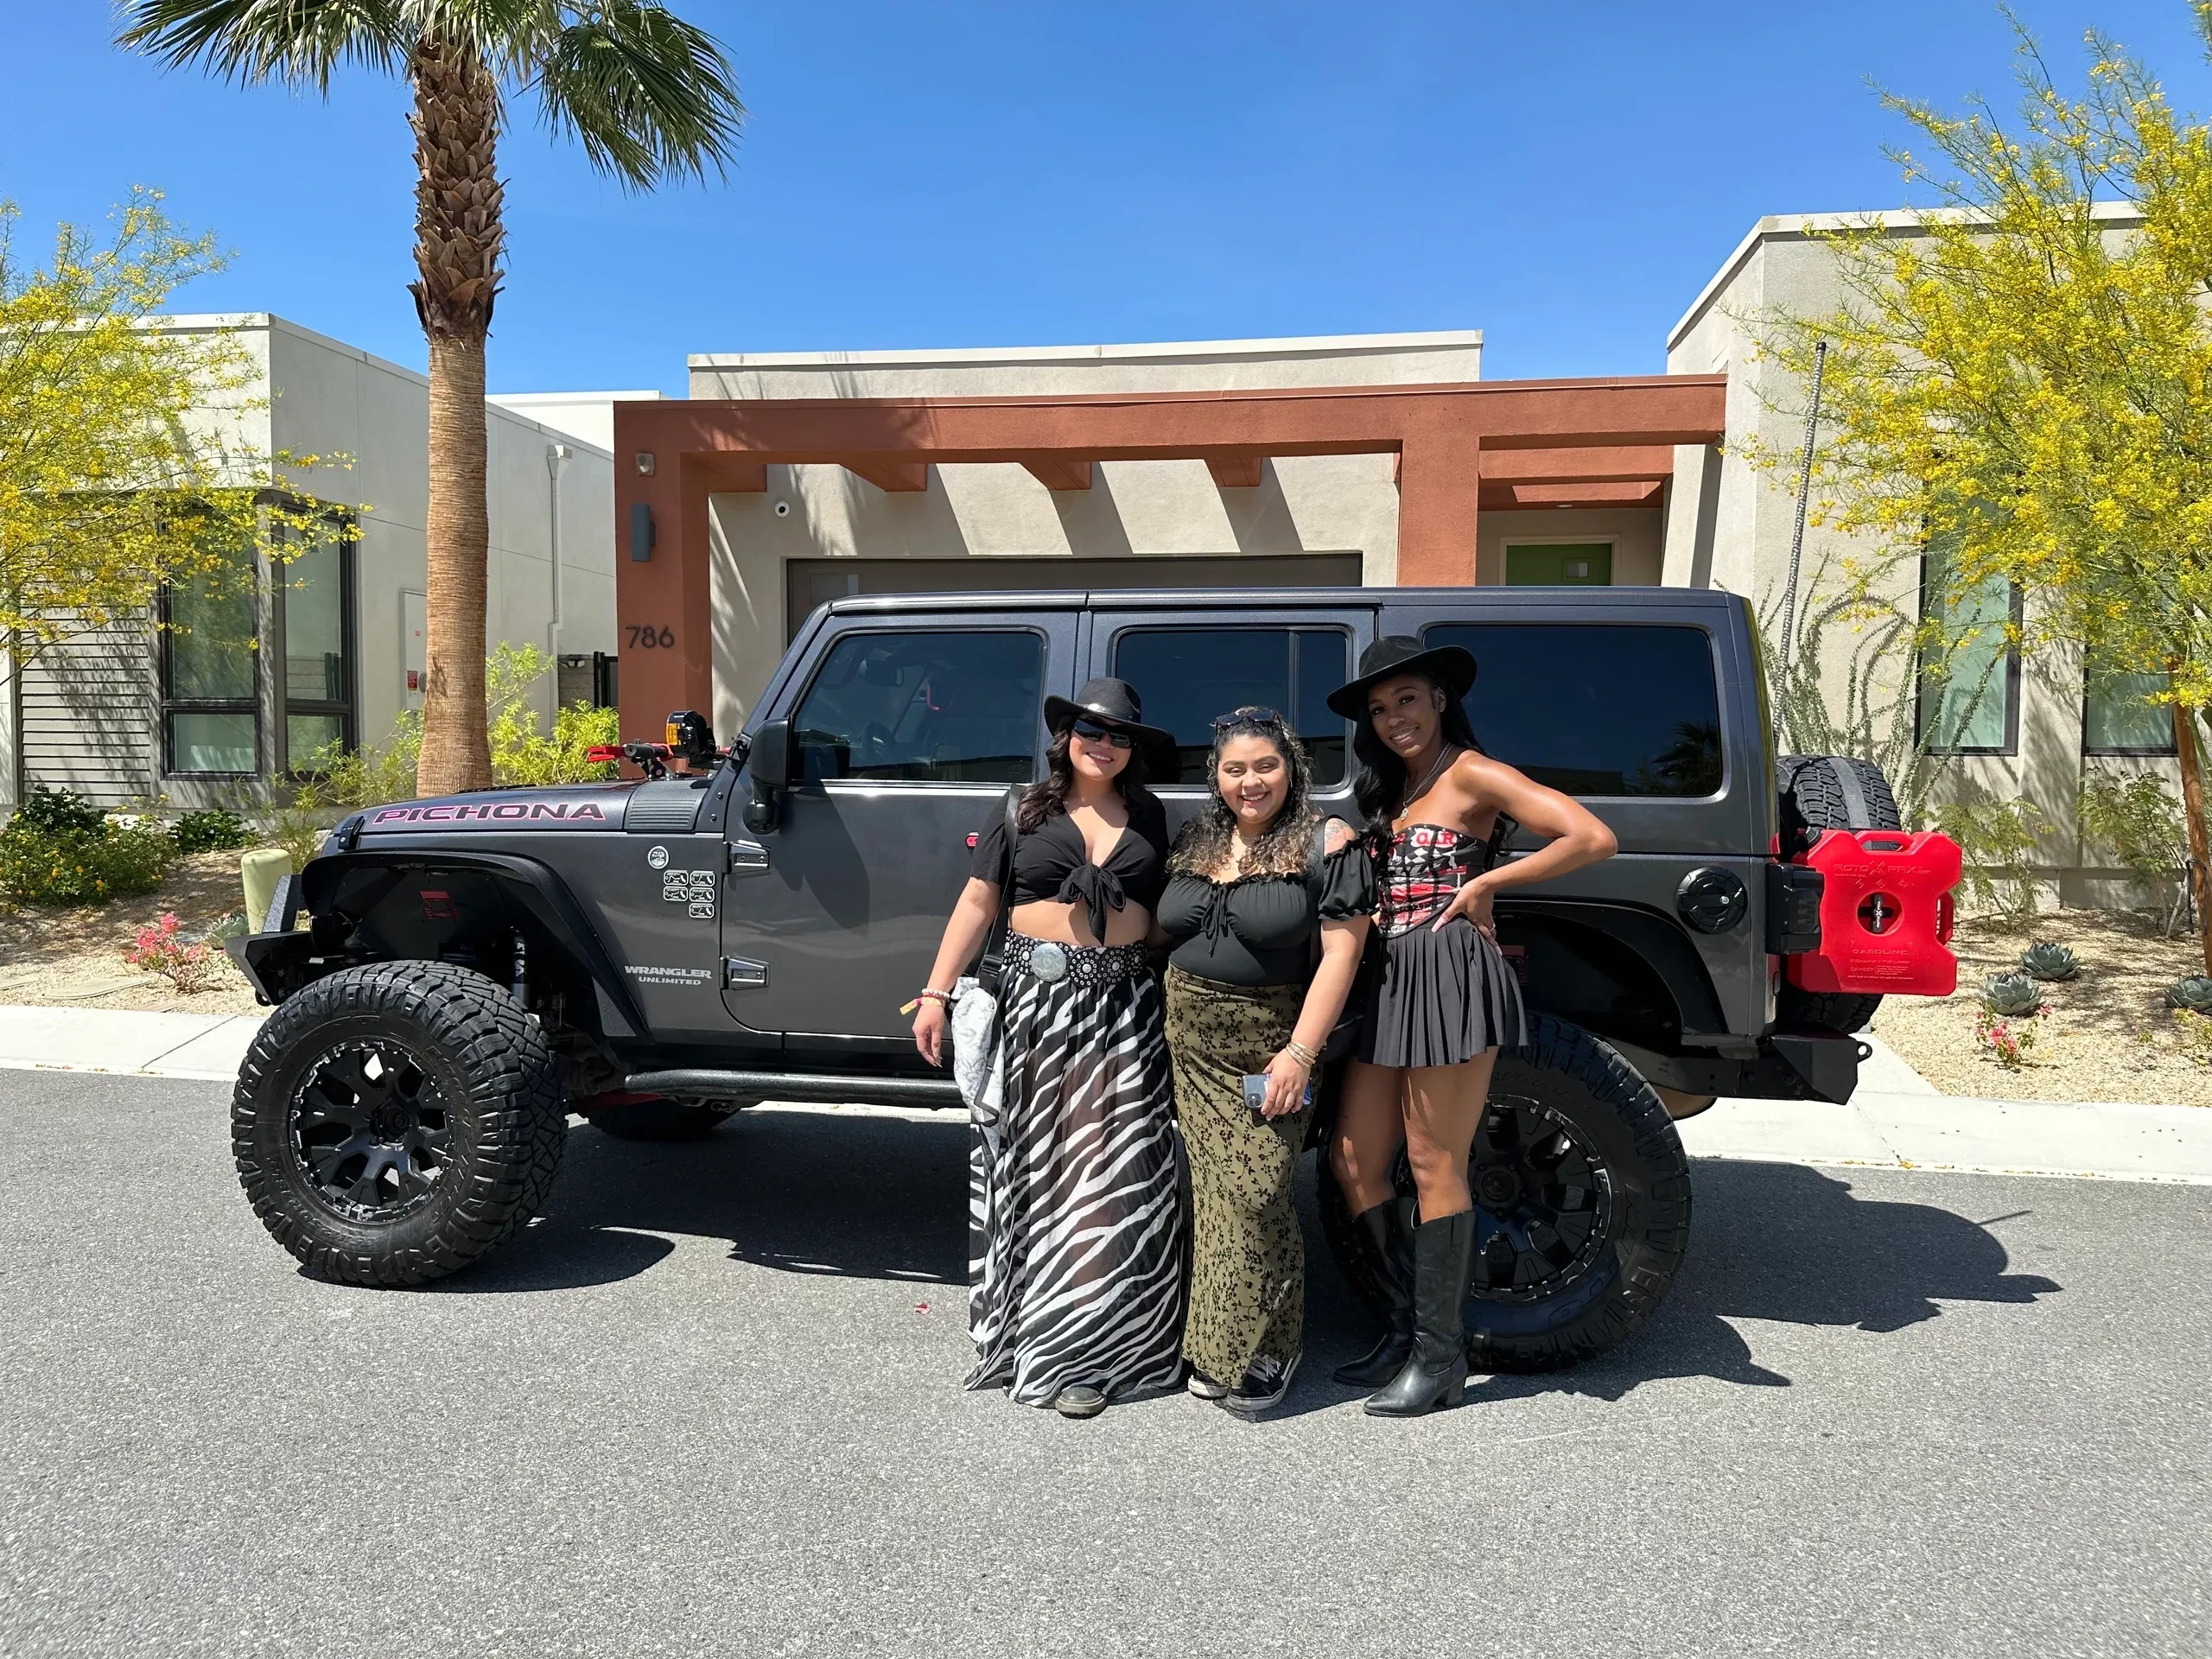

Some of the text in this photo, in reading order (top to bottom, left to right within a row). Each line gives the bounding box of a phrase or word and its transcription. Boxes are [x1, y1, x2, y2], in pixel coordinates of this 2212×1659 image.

[625, 626, 675, 649] 786
[372, 803, 607, 825] PICHONA
[624, 965, 713, 980] WRANGLER
[638, 976, 702, 986] UNLIMITED
